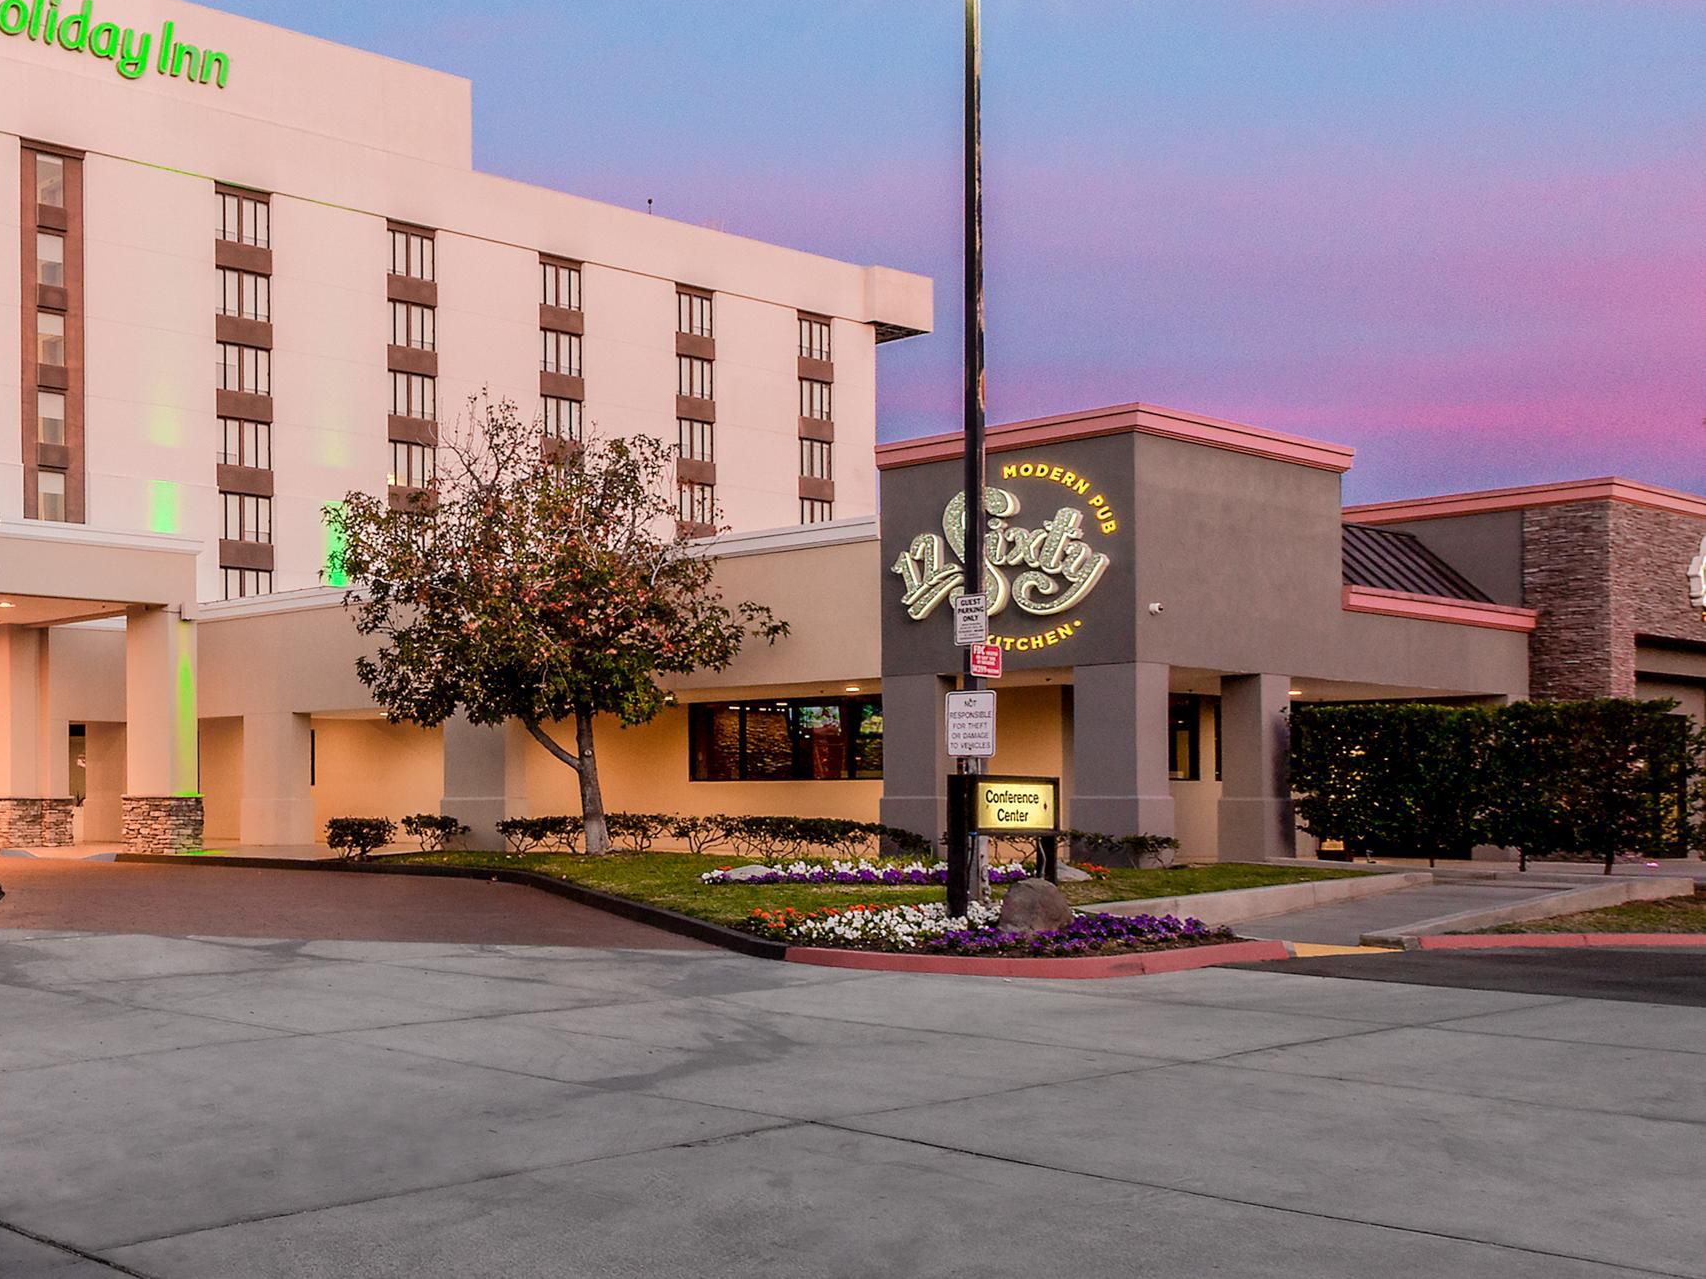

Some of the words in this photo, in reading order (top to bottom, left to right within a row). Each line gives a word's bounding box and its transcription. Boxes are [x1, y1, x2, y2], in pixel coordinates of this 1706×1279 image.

[157, 20, 230, 89] Inn
[1002, 463, 1091, 495] MODERN
[1088, 494, 1117, 535] PUB
[960, 598, 981, 606] GUEST
[957, 606, 984, 614] PARKING
[949, 710, 993, 719] RESPONSIBLE
[952, 722, 966, 730] FOR
[968, 721, 988, 729] THEFT
[951, 732, 961, 740] OR
[962, 731, 989, 739] DAMAGE
[960, 741, 991, 749] VEHICLES
[985, 789, 1040, 804] Conference
[997, 808, 1029, 822] Center
